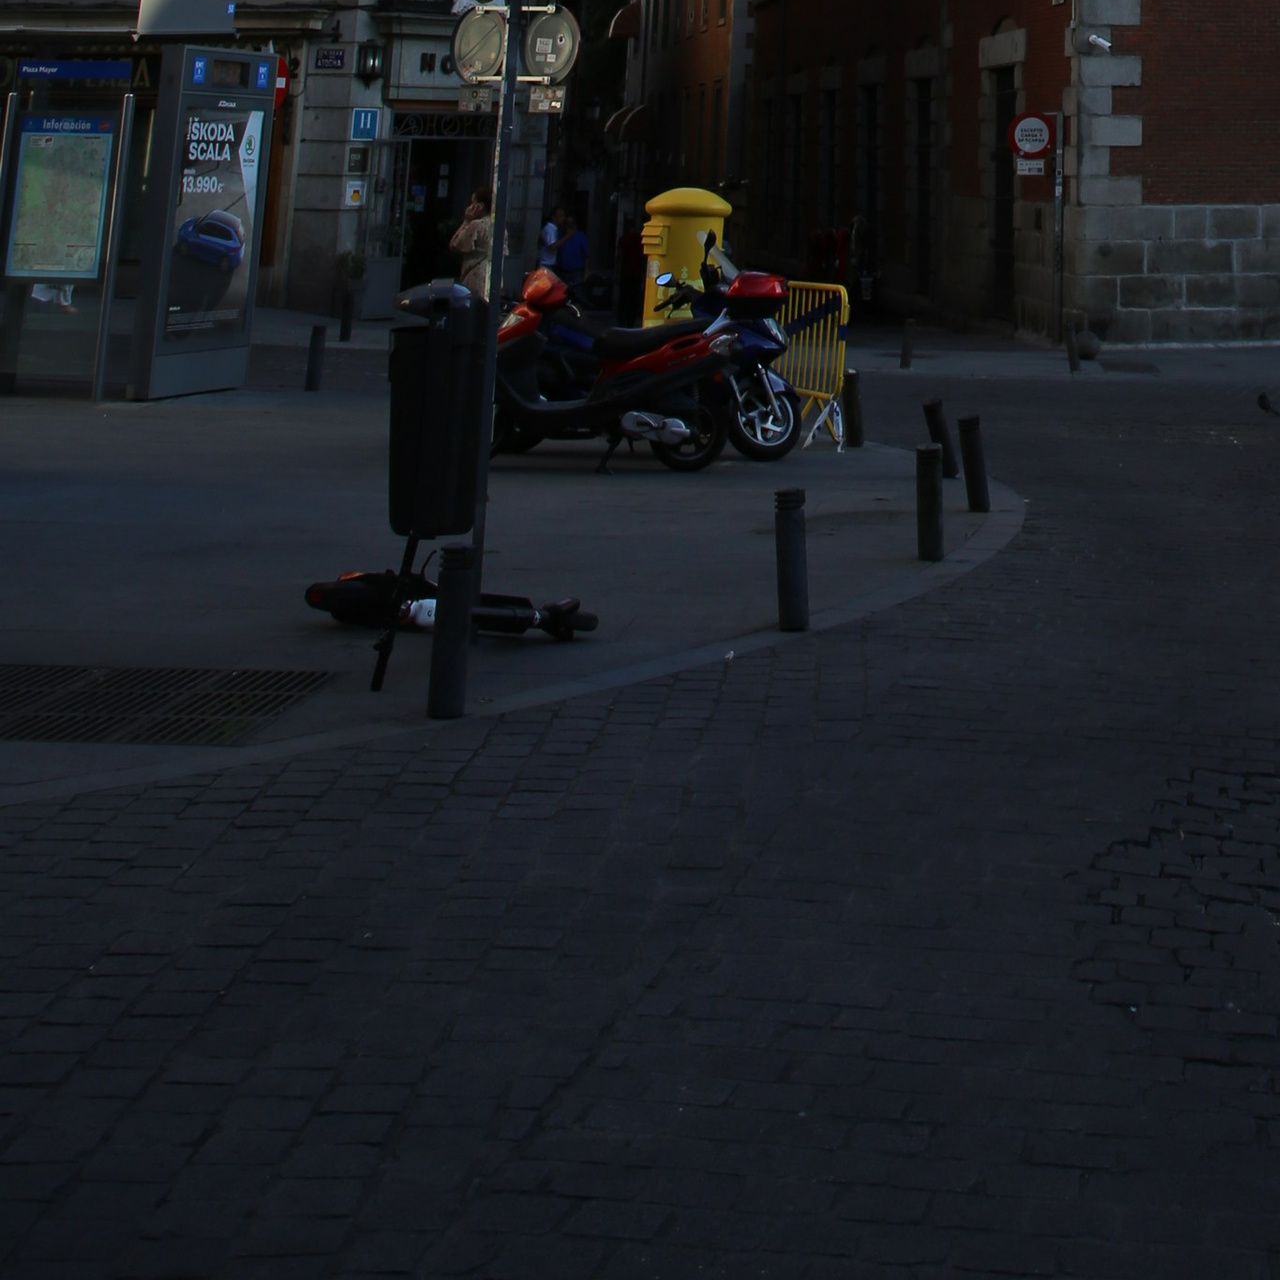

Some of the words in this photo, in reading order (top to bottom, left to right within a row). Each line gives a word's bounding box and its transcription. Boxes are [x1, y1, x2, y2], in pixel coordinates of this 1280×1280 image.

[22, 65, 38, 73] Plaza
[39, 65, 58, 75] Mayor
[317, 58, 342, 68] ATOCHA
[43, 118, 91, 131] Información
[360, 112, 371, 129] H
[190, 117, 235, 142] ŠKODA
[188, 142, 231, 161] SCALA
